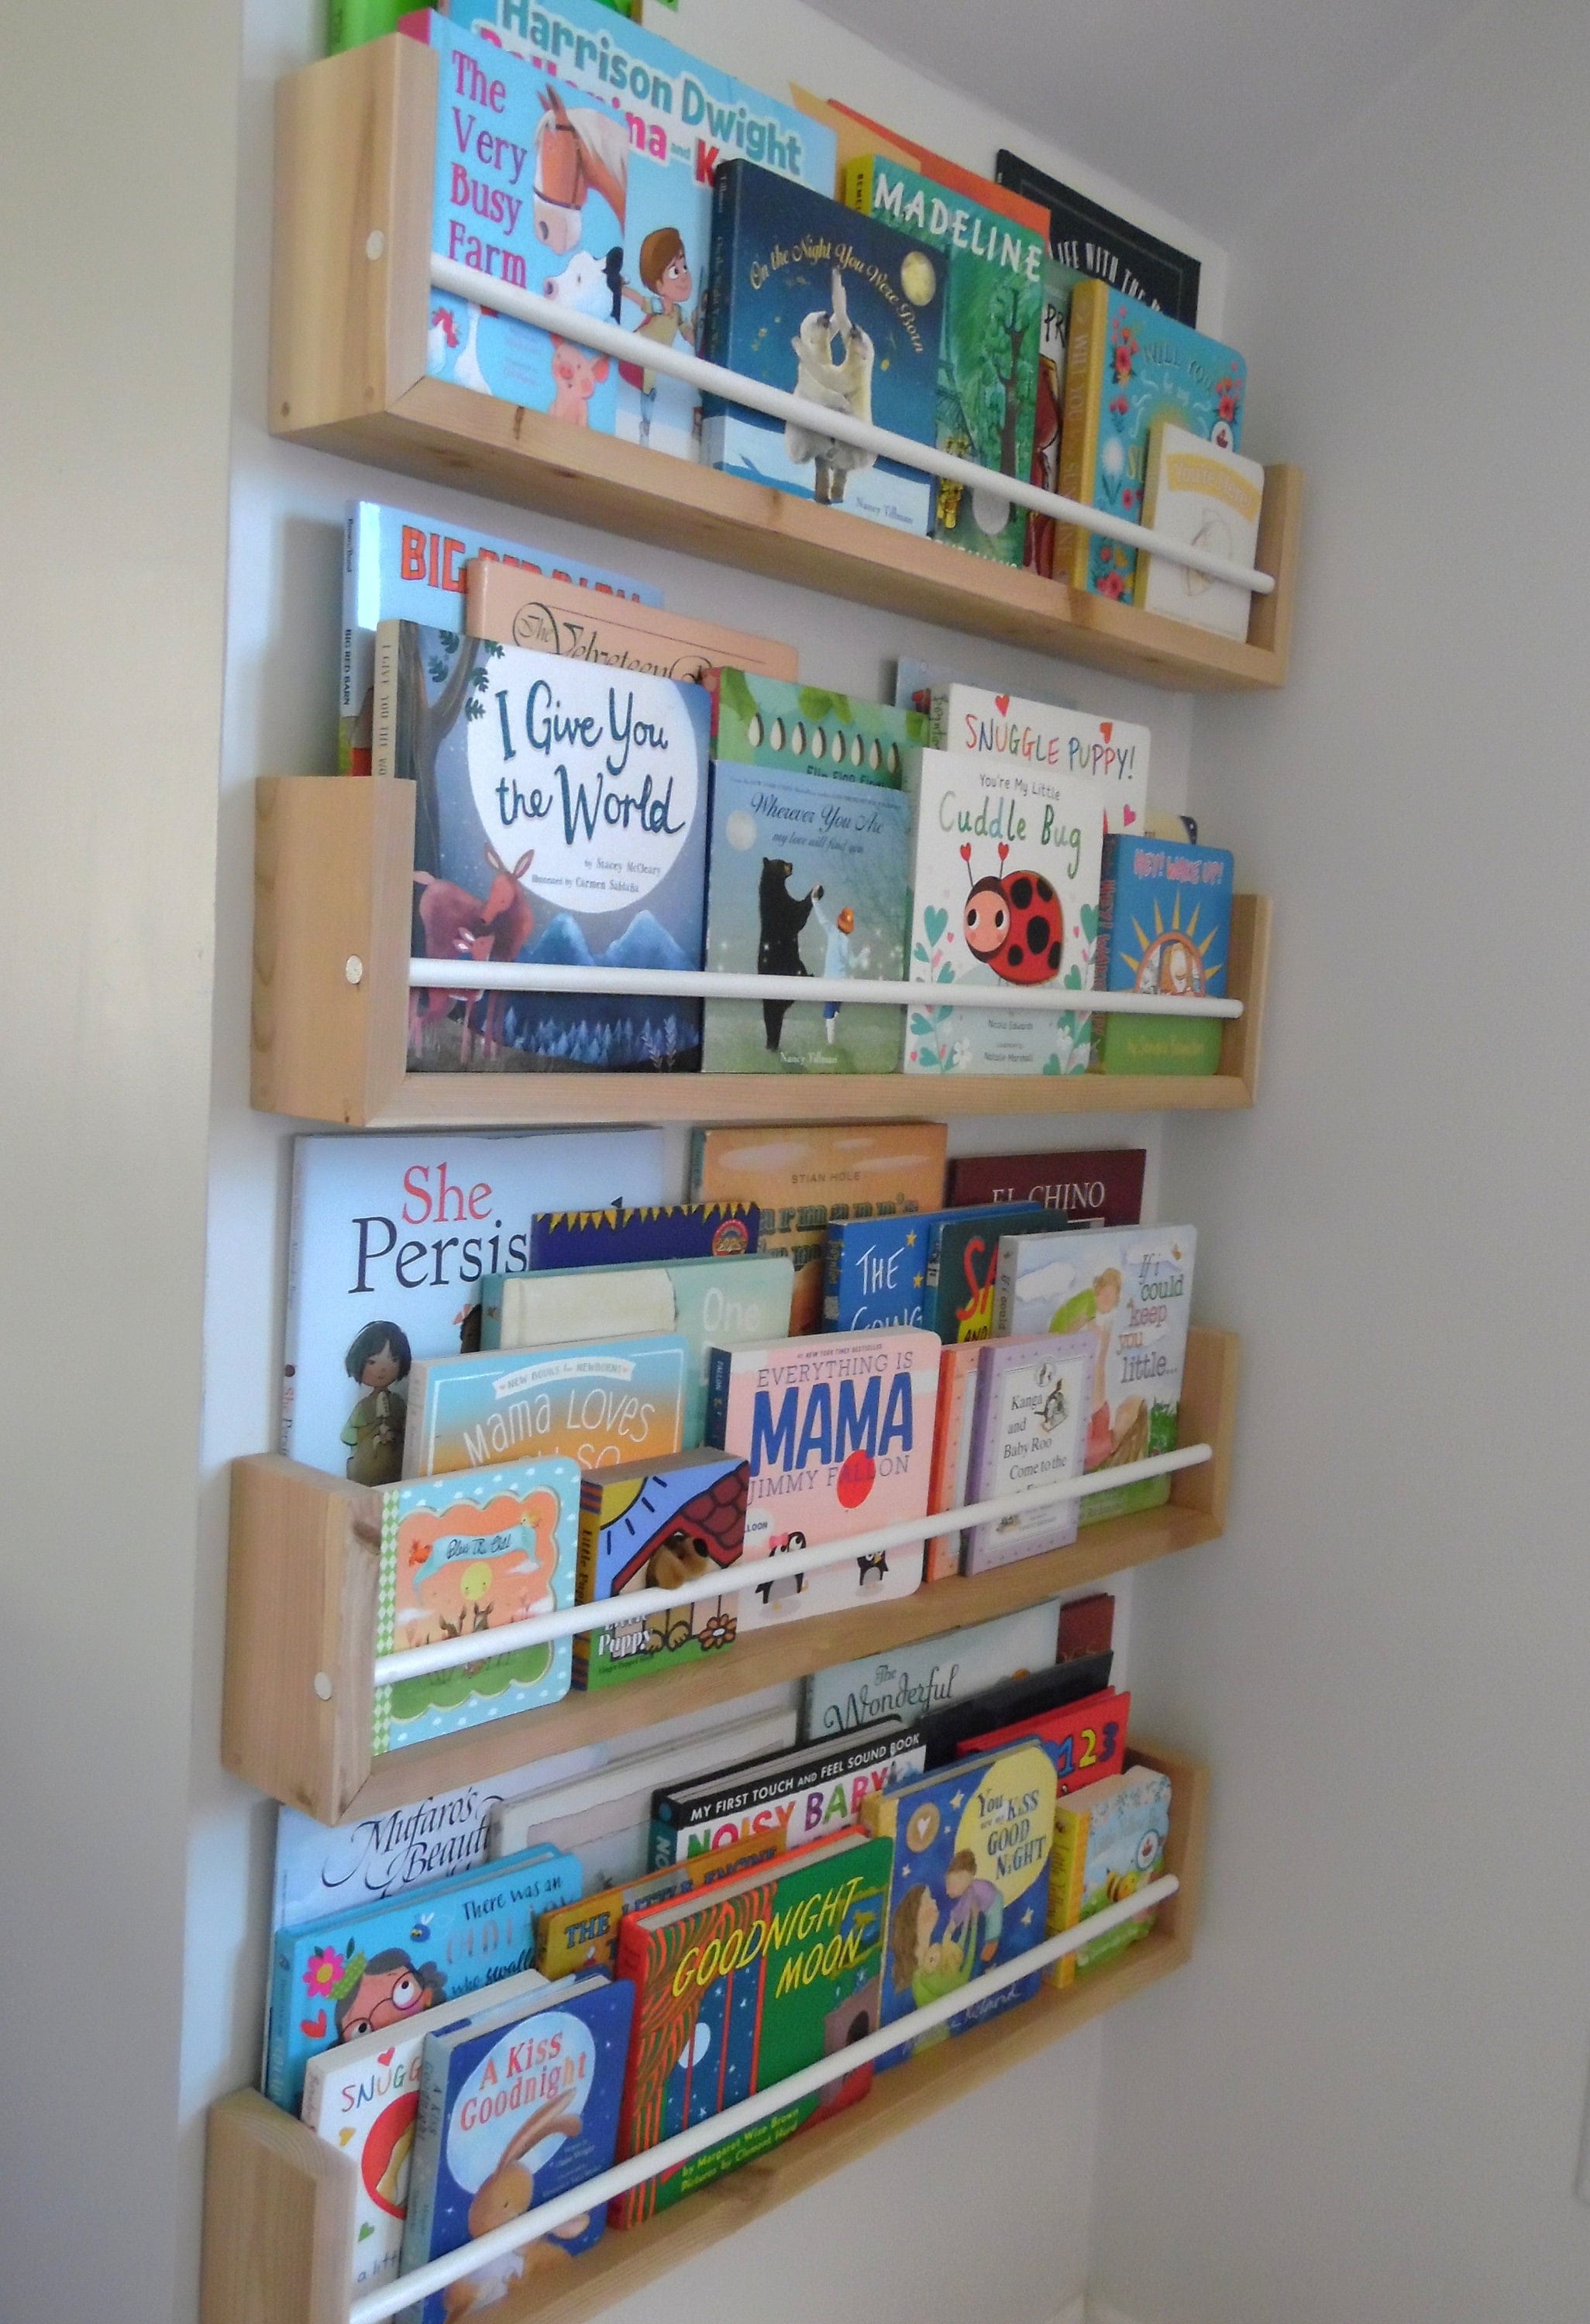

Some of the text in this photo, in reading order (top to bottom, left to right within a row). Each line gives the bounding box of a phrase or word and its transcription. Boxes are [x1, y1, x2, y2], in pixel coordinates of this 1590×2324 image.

[452, 49, 507, 114] The
[502, 0, 672, 114] Harrison
[682, 78, 802, 176] Dwight
[453, 107, 527, 185] Very
[450, 161, 523, 235] Busy
[874, 173, 1044, 282] MADELINE
[449, 219, 527, 290] Farm
[770, 244, 790, 271] the
[791, 235, 832, 263] Night
[835, 242, 866, 274] You
[866, 265, 900, 304] Were
[400, 524, 467, 594] BIG
[342, 629, 353, 706] BIG RED BARN
[495, 679, 669, 776] I Give You
[965, 713, 1135, 782] SNUGGLE PUPPY!
[494, 776, 553, 827] the
[554, 764, 686, 845] World
[751, 792, 816, 824] Wherever
[819, 804, 852, 834] You
[979, 773, 1061, 801] You're My Little
[938, 790, 1027, 843] Cuddle
[1041, 808, 1083, 880] Bug
[780, 1050, 806, 1068] Nancy
[402, 1162, 494, 1225] She
[791, 1171, 861, 1184] STIAN HOLE
[1029, 1181, 1106, 1210] CHINO
[348, 1215, 528, 1294] Persis
[855, 1244, 905, 1296] THE
[1128, 1301, 1168, 1328] keep
[1141, 1276, 1184, 1301] could
[757, 1351, 914, 1389] EVERYTHING IS
[1117, 1332, 1144, 1356] you
[507, 1376, 528, 1390] NEW
[532, 1366, 559, 1380] BOOKS
[1010, 1391, 1043, 1411] Kanga
[463, 1393, 551, 1468] Mama
[750, 1371, 913, 1477] MAMA
[1003, 1435, 1053, 1460] Baby Roo
[1007, 1418, 1027, 1435] and
[748, 1469, 825, 1506] JIMMY
[1009, 1455, 1069, 1480] Come to the
[824, 1663, 960, 1730] Wonderful
[874, 1664, 897, 1686] The
[1078, 1728, 1097, 1769] 2
[1100, 1721, 1119, 1762] 3
[690, 1731, 921, 1823] MY FIRST TOUCH AND FEEL SOUND BOOK
[333, 1786, 478, 1868] Mufaro's
[687, 1800, 797, 1859] NOISY
[804, 1766, 889, 1831] BABY
[987, 1818, 1030, 1855] GOOD
[463, 1875, 562, 1920] There was an
[564, 1911, 613, 1948] THE
[672, 1876, 865, 1998] GOODNIGHT
[775, 1928, 866, 1999] MOON
[342, 2056, 423, 2113] SNUGG
[459, 2051, 587, 2132] Goodnight
[479, 2032, 563, 2090] A Kiss
